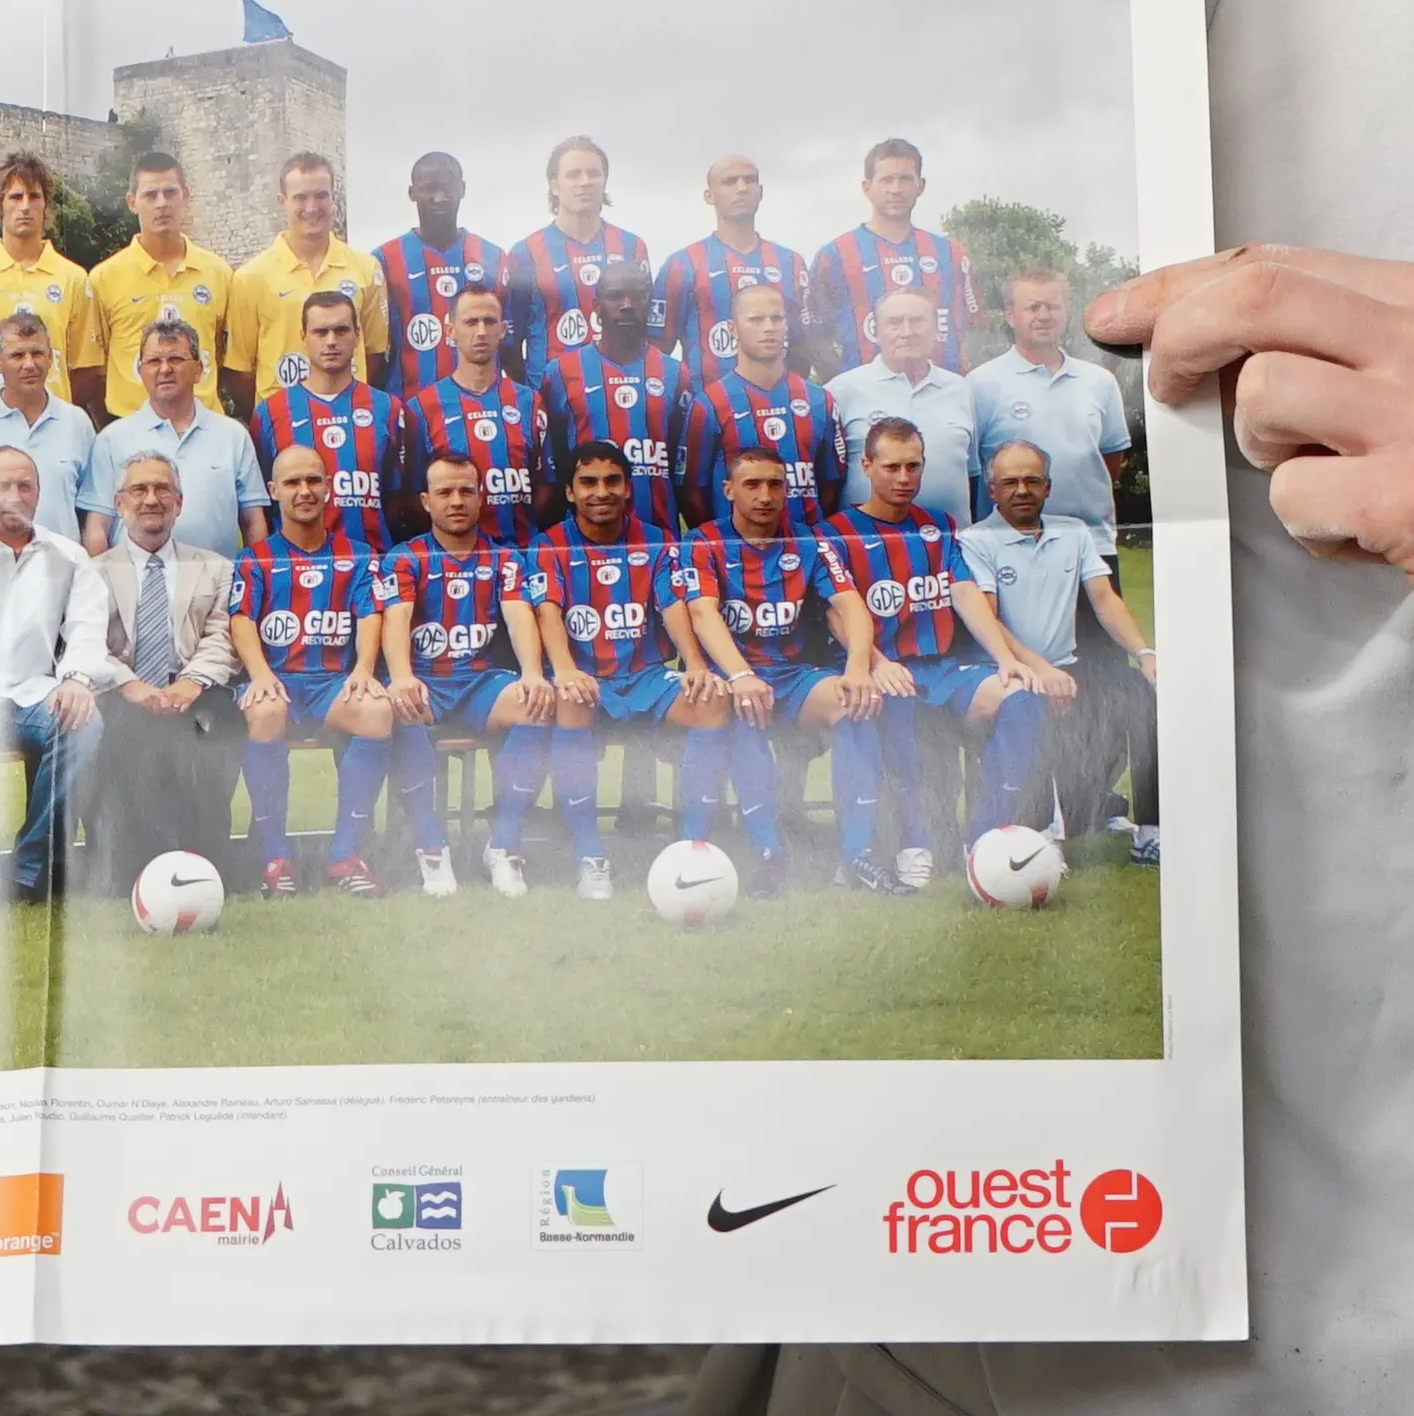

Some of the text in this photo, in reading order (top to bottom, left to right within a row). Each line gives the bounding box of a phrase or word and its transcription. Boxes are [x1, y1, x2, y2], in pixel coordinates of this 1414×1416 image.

[624, 438, 669, 467] GDE
[333, 471, 380, 496] GDE
[485, 468, 532, 493] GDE
[907, 571, 950, 602] GDE
[304, 610, 352, 635] GDE
[371, 1164, 463, 1177] Conseil Général
[906, 1159, 1072, 1210] ouest
[539, 1169, 553, 1227] Région
[127, 1196, 261, 1234] CAEN
[883, 1201, 1073, 1254] france
[217, 1234, 260, 1246] mairie
[371, 1233, 463, 1252] Calvados
[539, 1231, 636, 1243] Basse-Normandie
